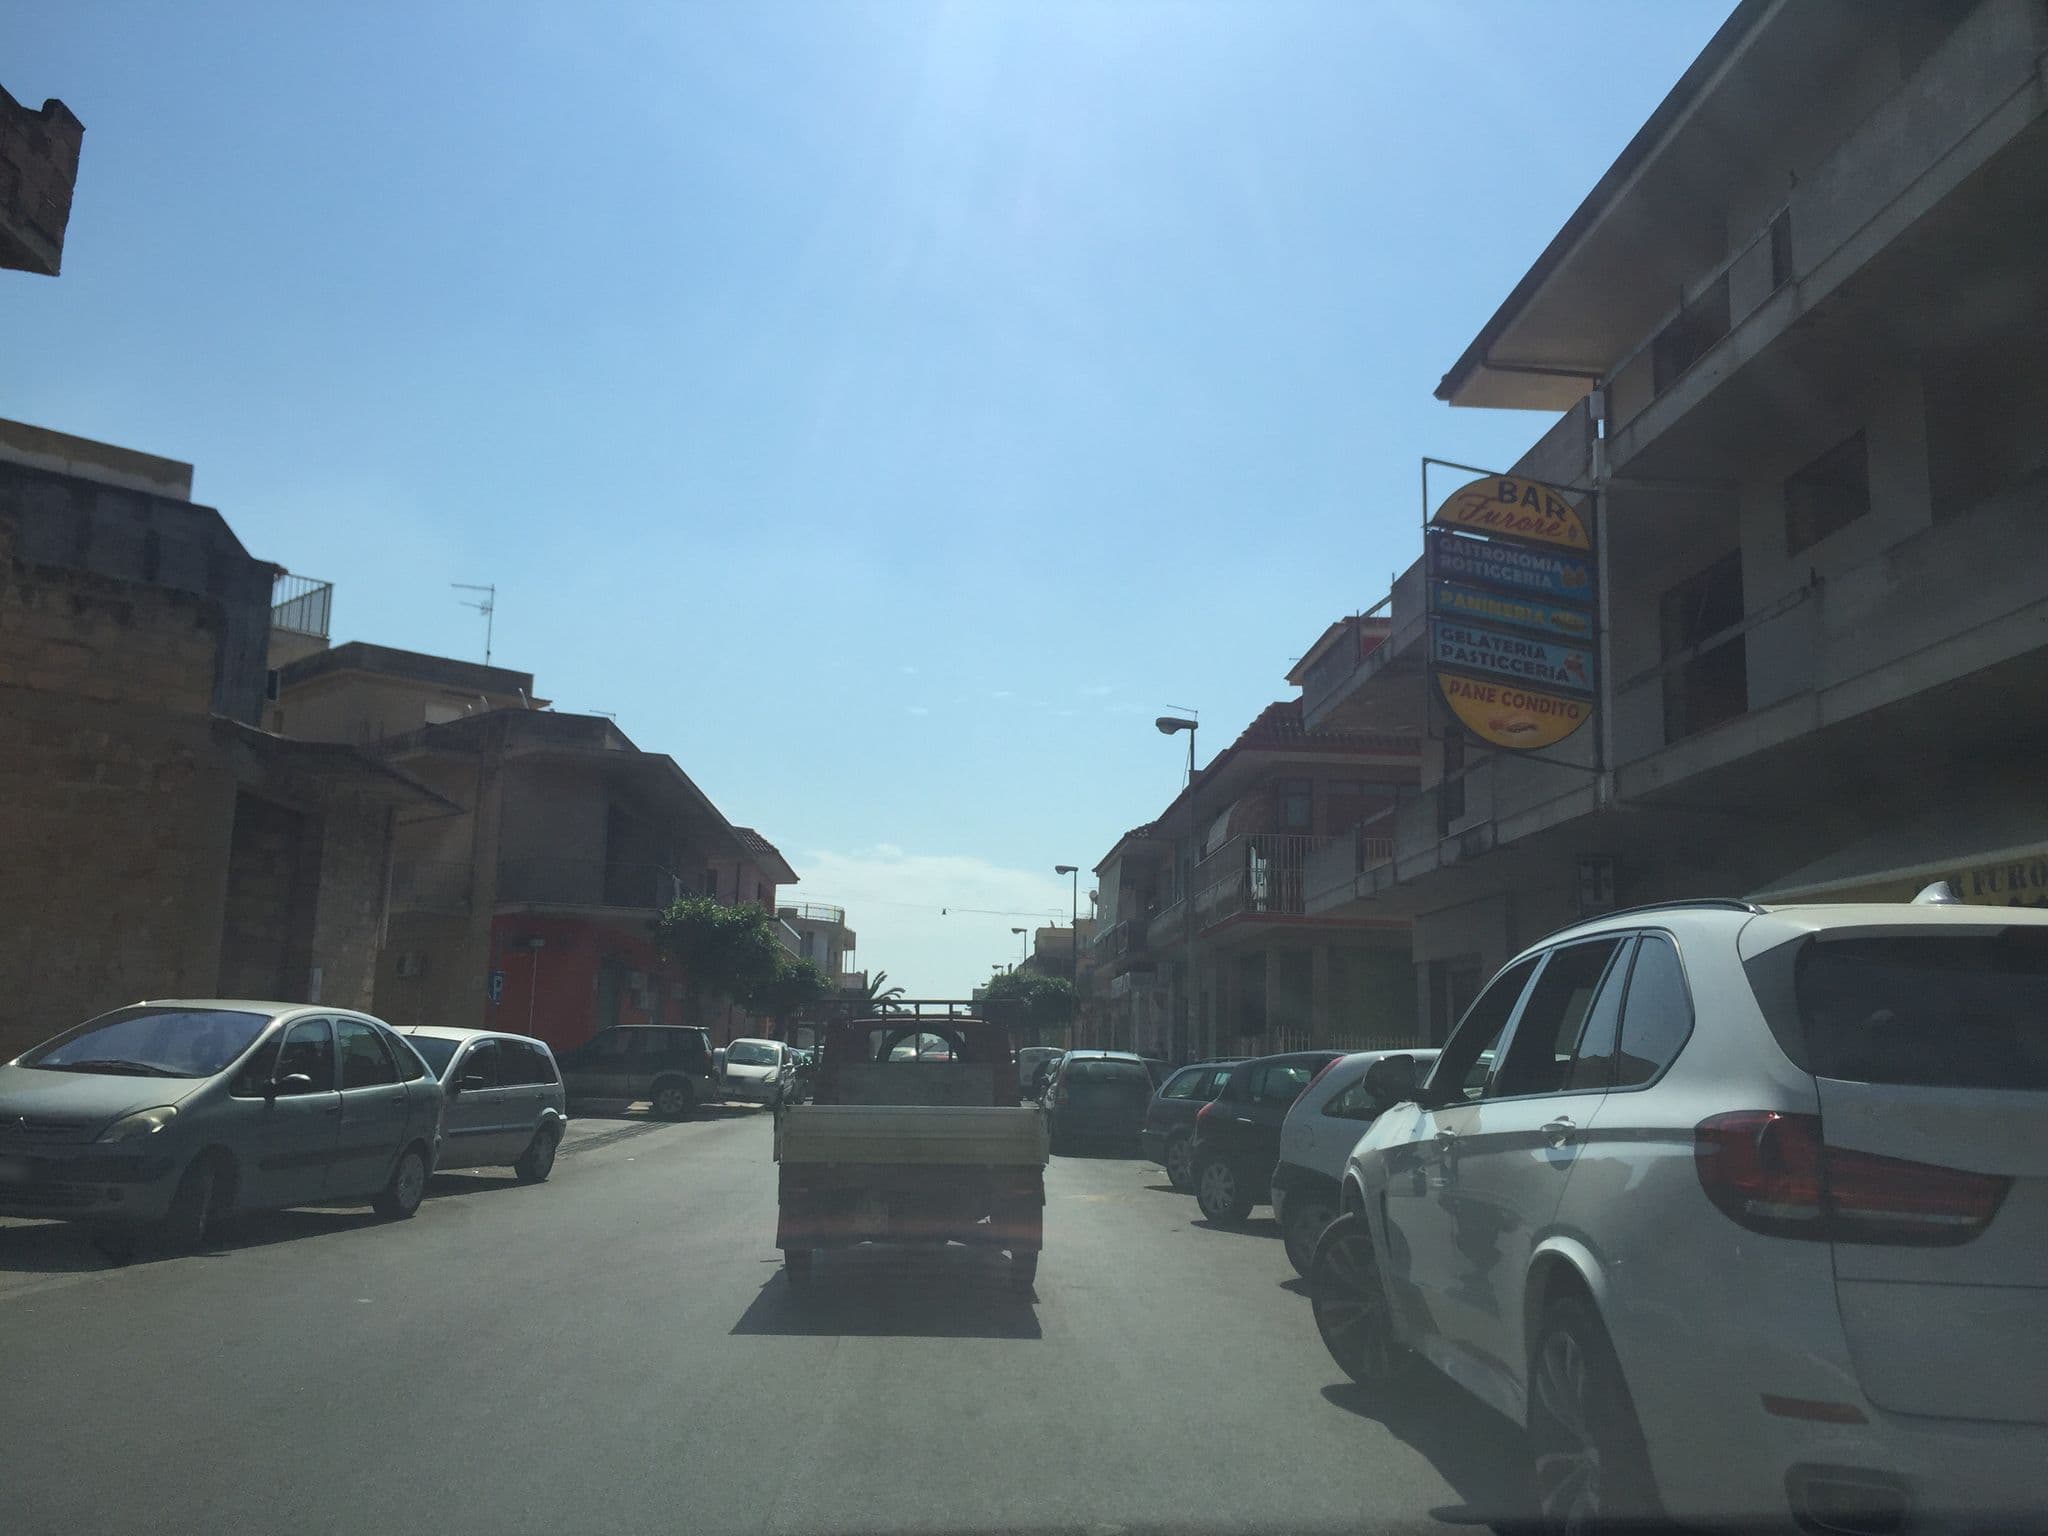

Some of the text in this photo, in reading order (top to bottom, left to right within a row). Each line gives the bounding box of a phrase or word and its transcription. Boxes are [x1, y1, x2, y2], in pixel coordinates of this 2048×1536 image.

[1457, 492, 1562, 536] Furore
[1498, 480, 1566, 521] BAR
[1440, 537, 1562, 573] GASTRONOMIA
[1440, 554, 1552, 588] ROSTICCERIA
[1441, 627, 1547, 660] GELATERIA
[1441, 643, 1570, 682] PASTICCERIA
[1449, 679, 1579, 720] PANE CONDITO
